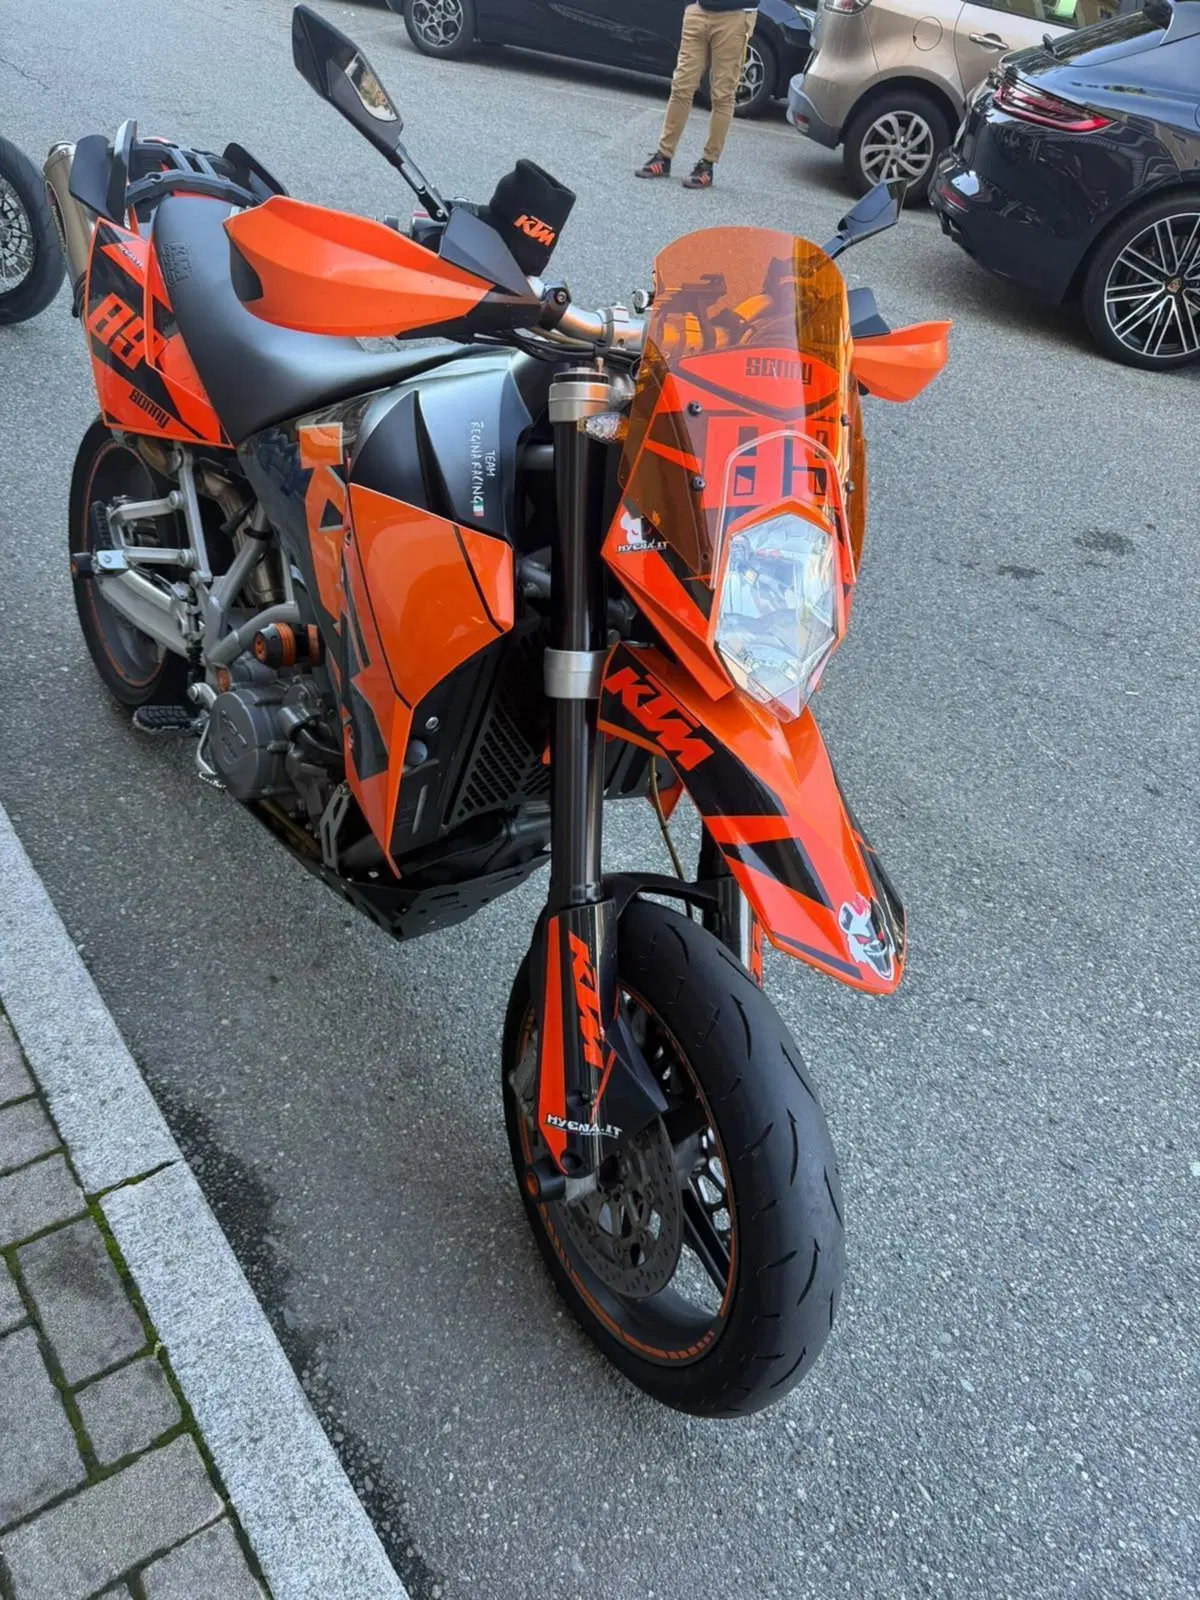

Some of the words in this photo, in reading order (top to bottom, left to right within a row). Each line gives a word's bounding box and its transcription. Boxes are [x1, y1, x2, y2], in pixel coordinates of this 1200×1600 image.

[513, 214, 556, 247] KTM
[88, 292, 169, 371] 89
[469, 421, 484, 459] REGINA
[470, 462, 484, 503] RACING
[485, 449, 496, 477] TEAM
[603, 666, 714, 771] KTM
[568, 930, 604, 1070] KTM
